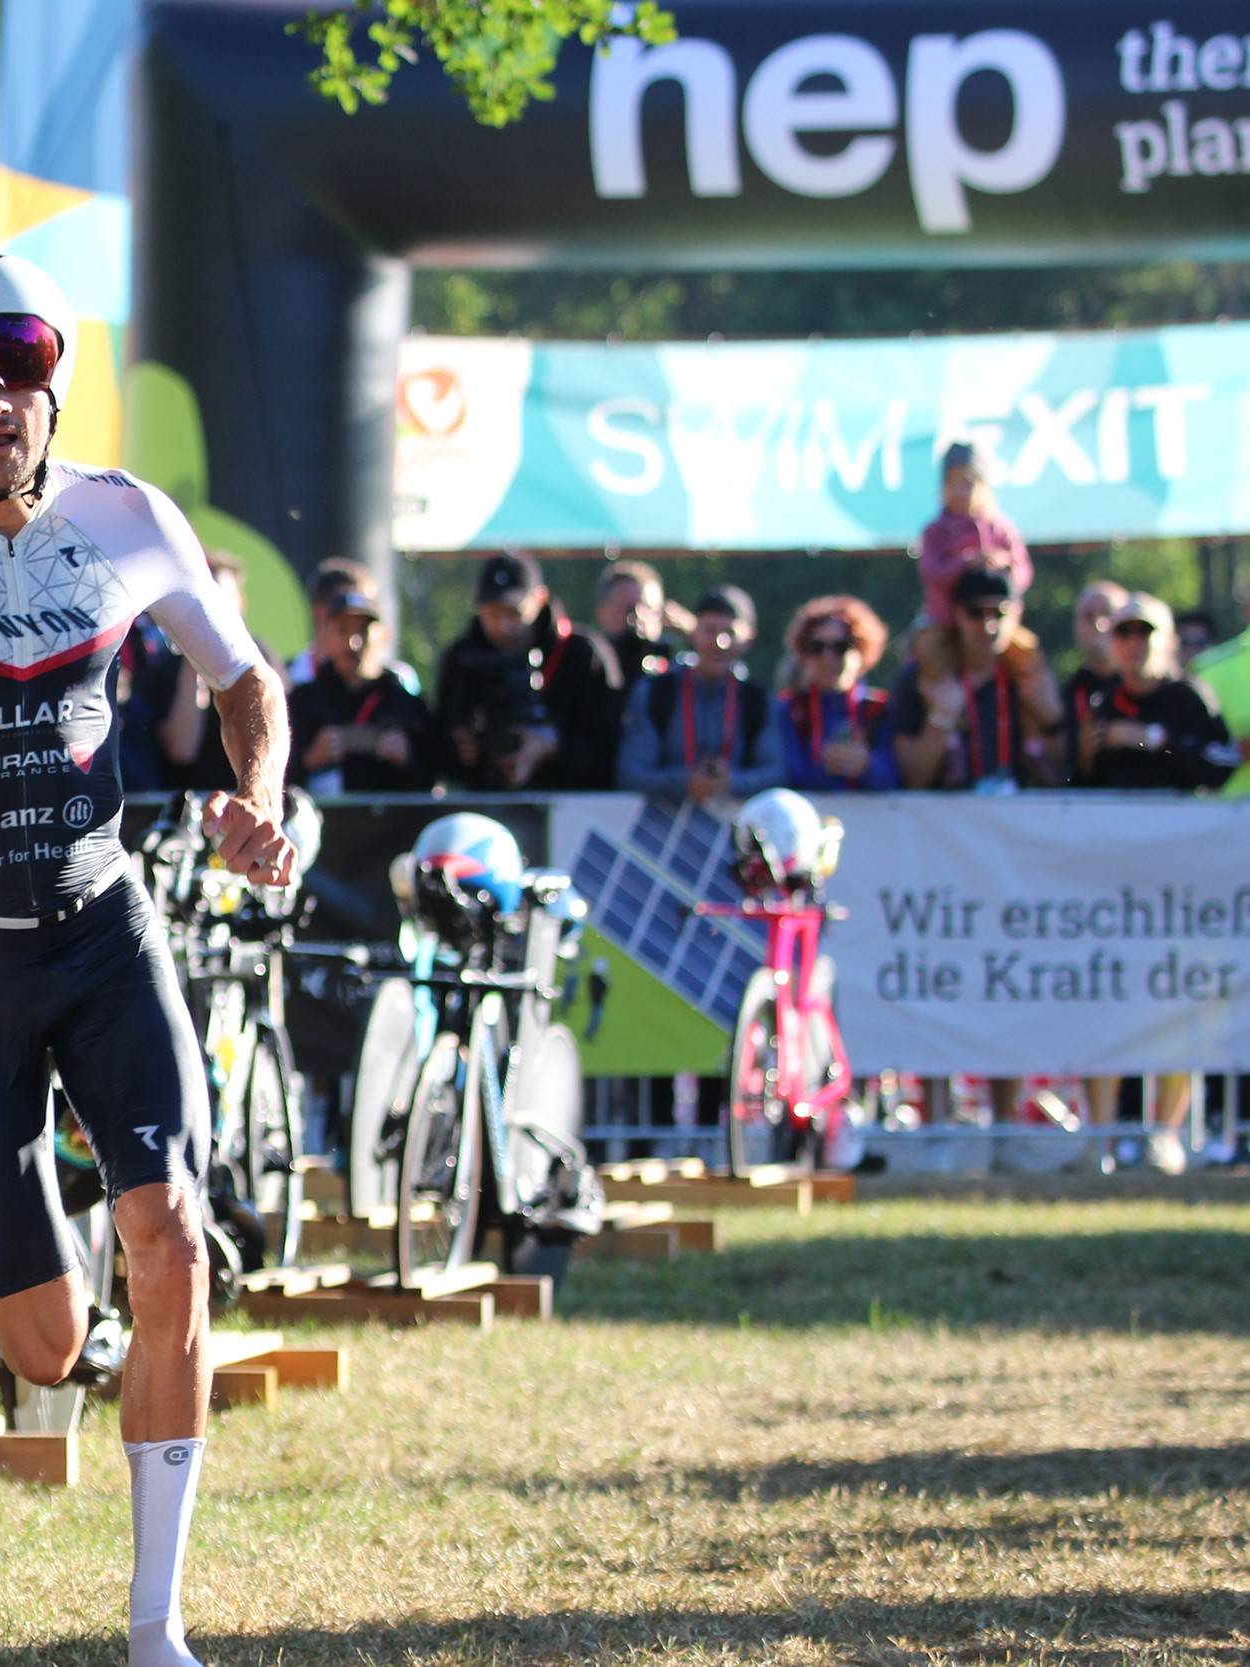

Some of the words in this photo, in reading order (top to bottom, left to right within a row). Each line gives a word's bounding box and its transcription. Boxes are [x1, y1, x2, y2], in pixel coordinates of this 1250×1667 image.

[588, 29, 1065, 234] nep
[8, 848, 30, 865] for
[880, 888, 982, 939] Wir
[876, 951, 962, 1001] die
[983, 947, 1125, 1001] Kraft
[1146, 947, 1237, 1001] der
